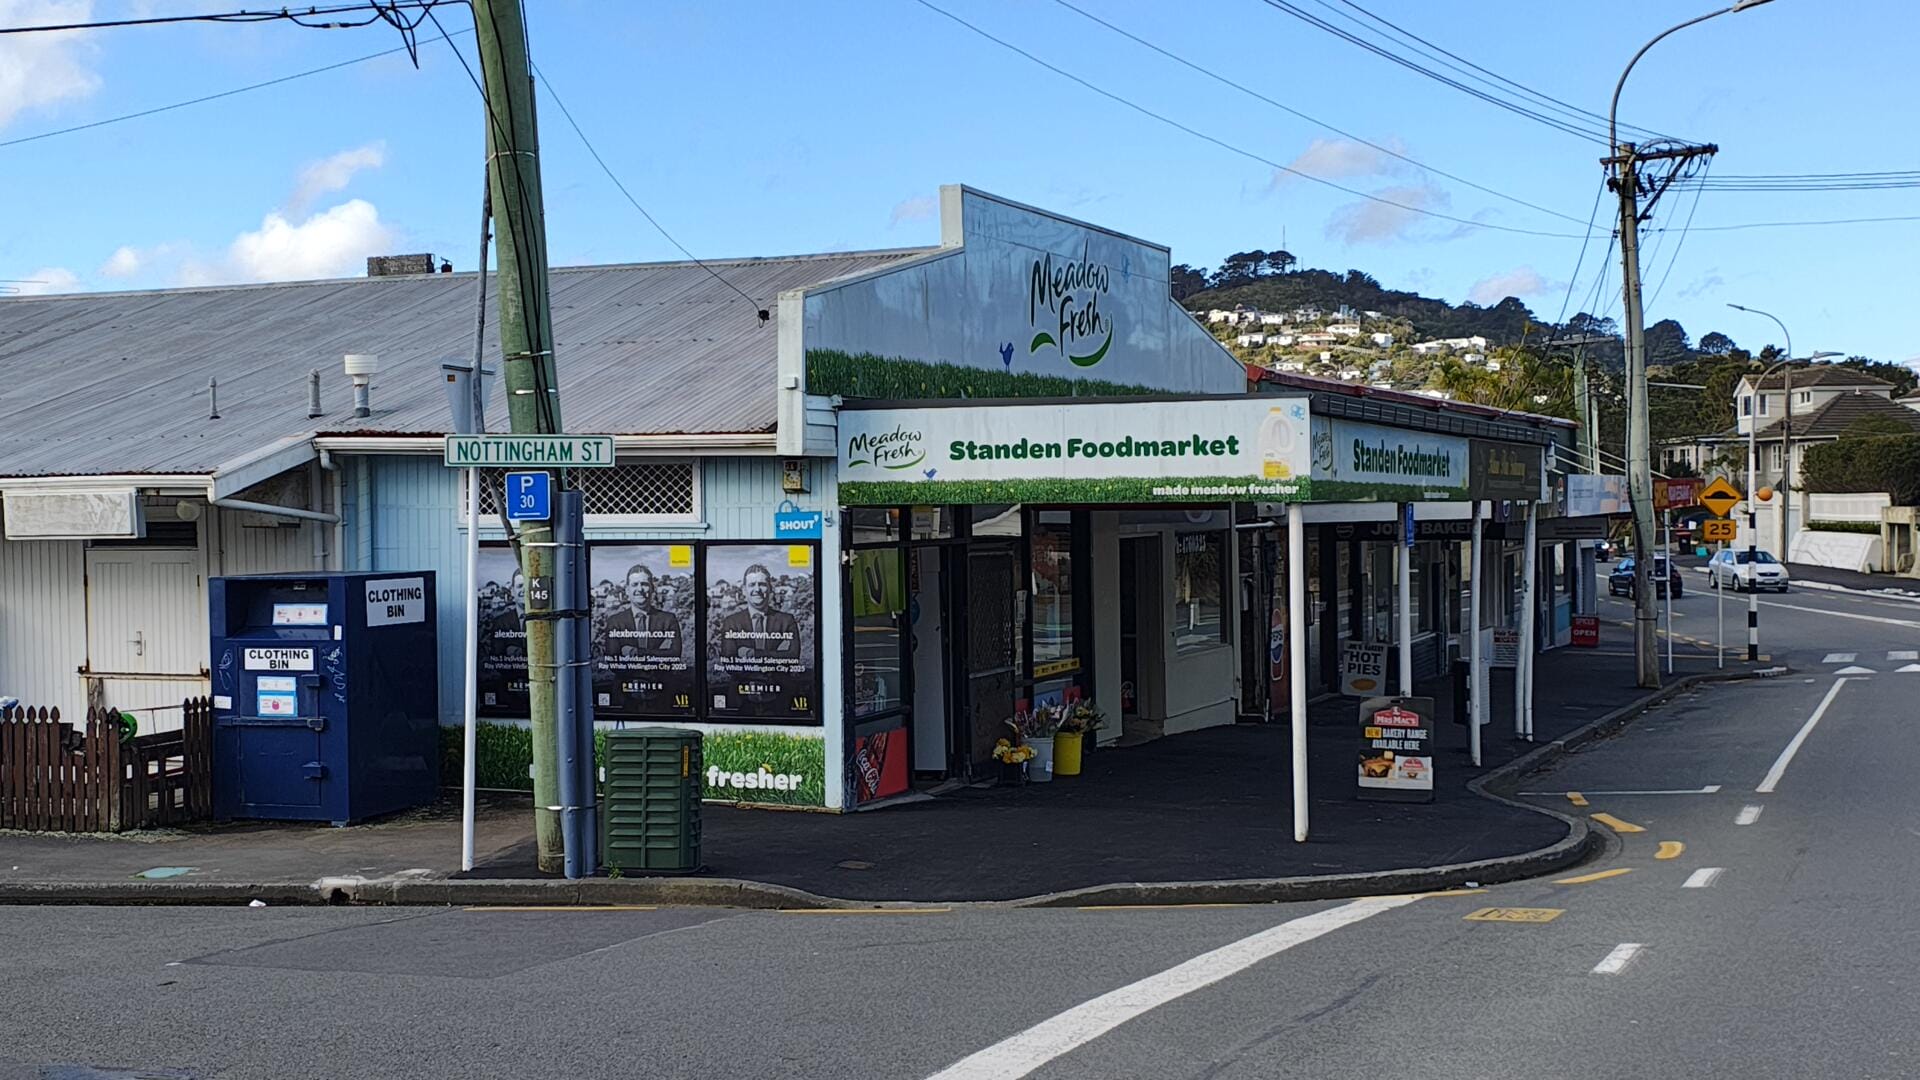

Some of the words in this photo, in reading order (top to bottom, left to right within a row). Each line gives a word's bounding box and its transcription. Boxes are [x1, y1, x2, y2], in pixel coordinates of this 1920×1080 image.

[1031, 238, 1109, 327] Meadow
[1060, 291, 1104, 357] Fresh
[849, 424, 921, 459] Meadow
[950, 438, 1061, 460] Standen
[1067, 434, 1239, 458] Foodmarket
[458, 441, 572, 461] NOTTINGHAM
[581, 441, 603, 461] ST
[874, 442, 916, 467] Fresh
[1353, 438, 1396, 474] Standen
[1397, 443, 1450, 478] Foodmarket
[520, 476, 534, 493] P
[1152, 484, 1189, 496] made
[1190, 483, 1247, 496] meadow
[1248, 483, 1299, 495] fresher
[520, 494, 535, 508] 30
[1709, 523, 1732, 536] 25
[532, 578, 541, 588] K
[368, 587, 422, 603] CLOTHING
[530, 590, 548, 600] 145
[387, 604, 405, 618] BIN
[608, 628, 675, 639] alexbrown.co.nz
[724, 629, 794, 640] alexbrown.co.nz
[249, 649, 309, 660] CLOTHING
[646, 655, 680, 663] Salesperson
[720, 656, 733, 664] No.1
[735, 656, 763, 664] Individual
[764, 656, 799, 665] Salesperson
[1349, 651, 1381, 664] HOT
[269, 660, 289, 669] BIN
[598, 662, 609, 670] Ray
[610, 662, 627, 670] White
[627, 662, 658, 671] Wellington
[658, 663, 671, 671] City
[714, 664, 725, 672] Ray
[726, 664, 743, 672] White
[744, 664, 775, 673] Wellington
[776, 664, 789, 673] City
[1347, 662, 1381, 676] PIES
[622, 682, 663, 690] PREMIER
[738, 684, 781, 692] PREMIER
[1382, 728, 1406, 739] BAKERY
[1406, 728, 1428, 740] RANGE
[1371, 739, 1403, 750] AVAILABLE
[1404, 740, 1420, 751] HERE
[706, 765, 803, 791] fresher
